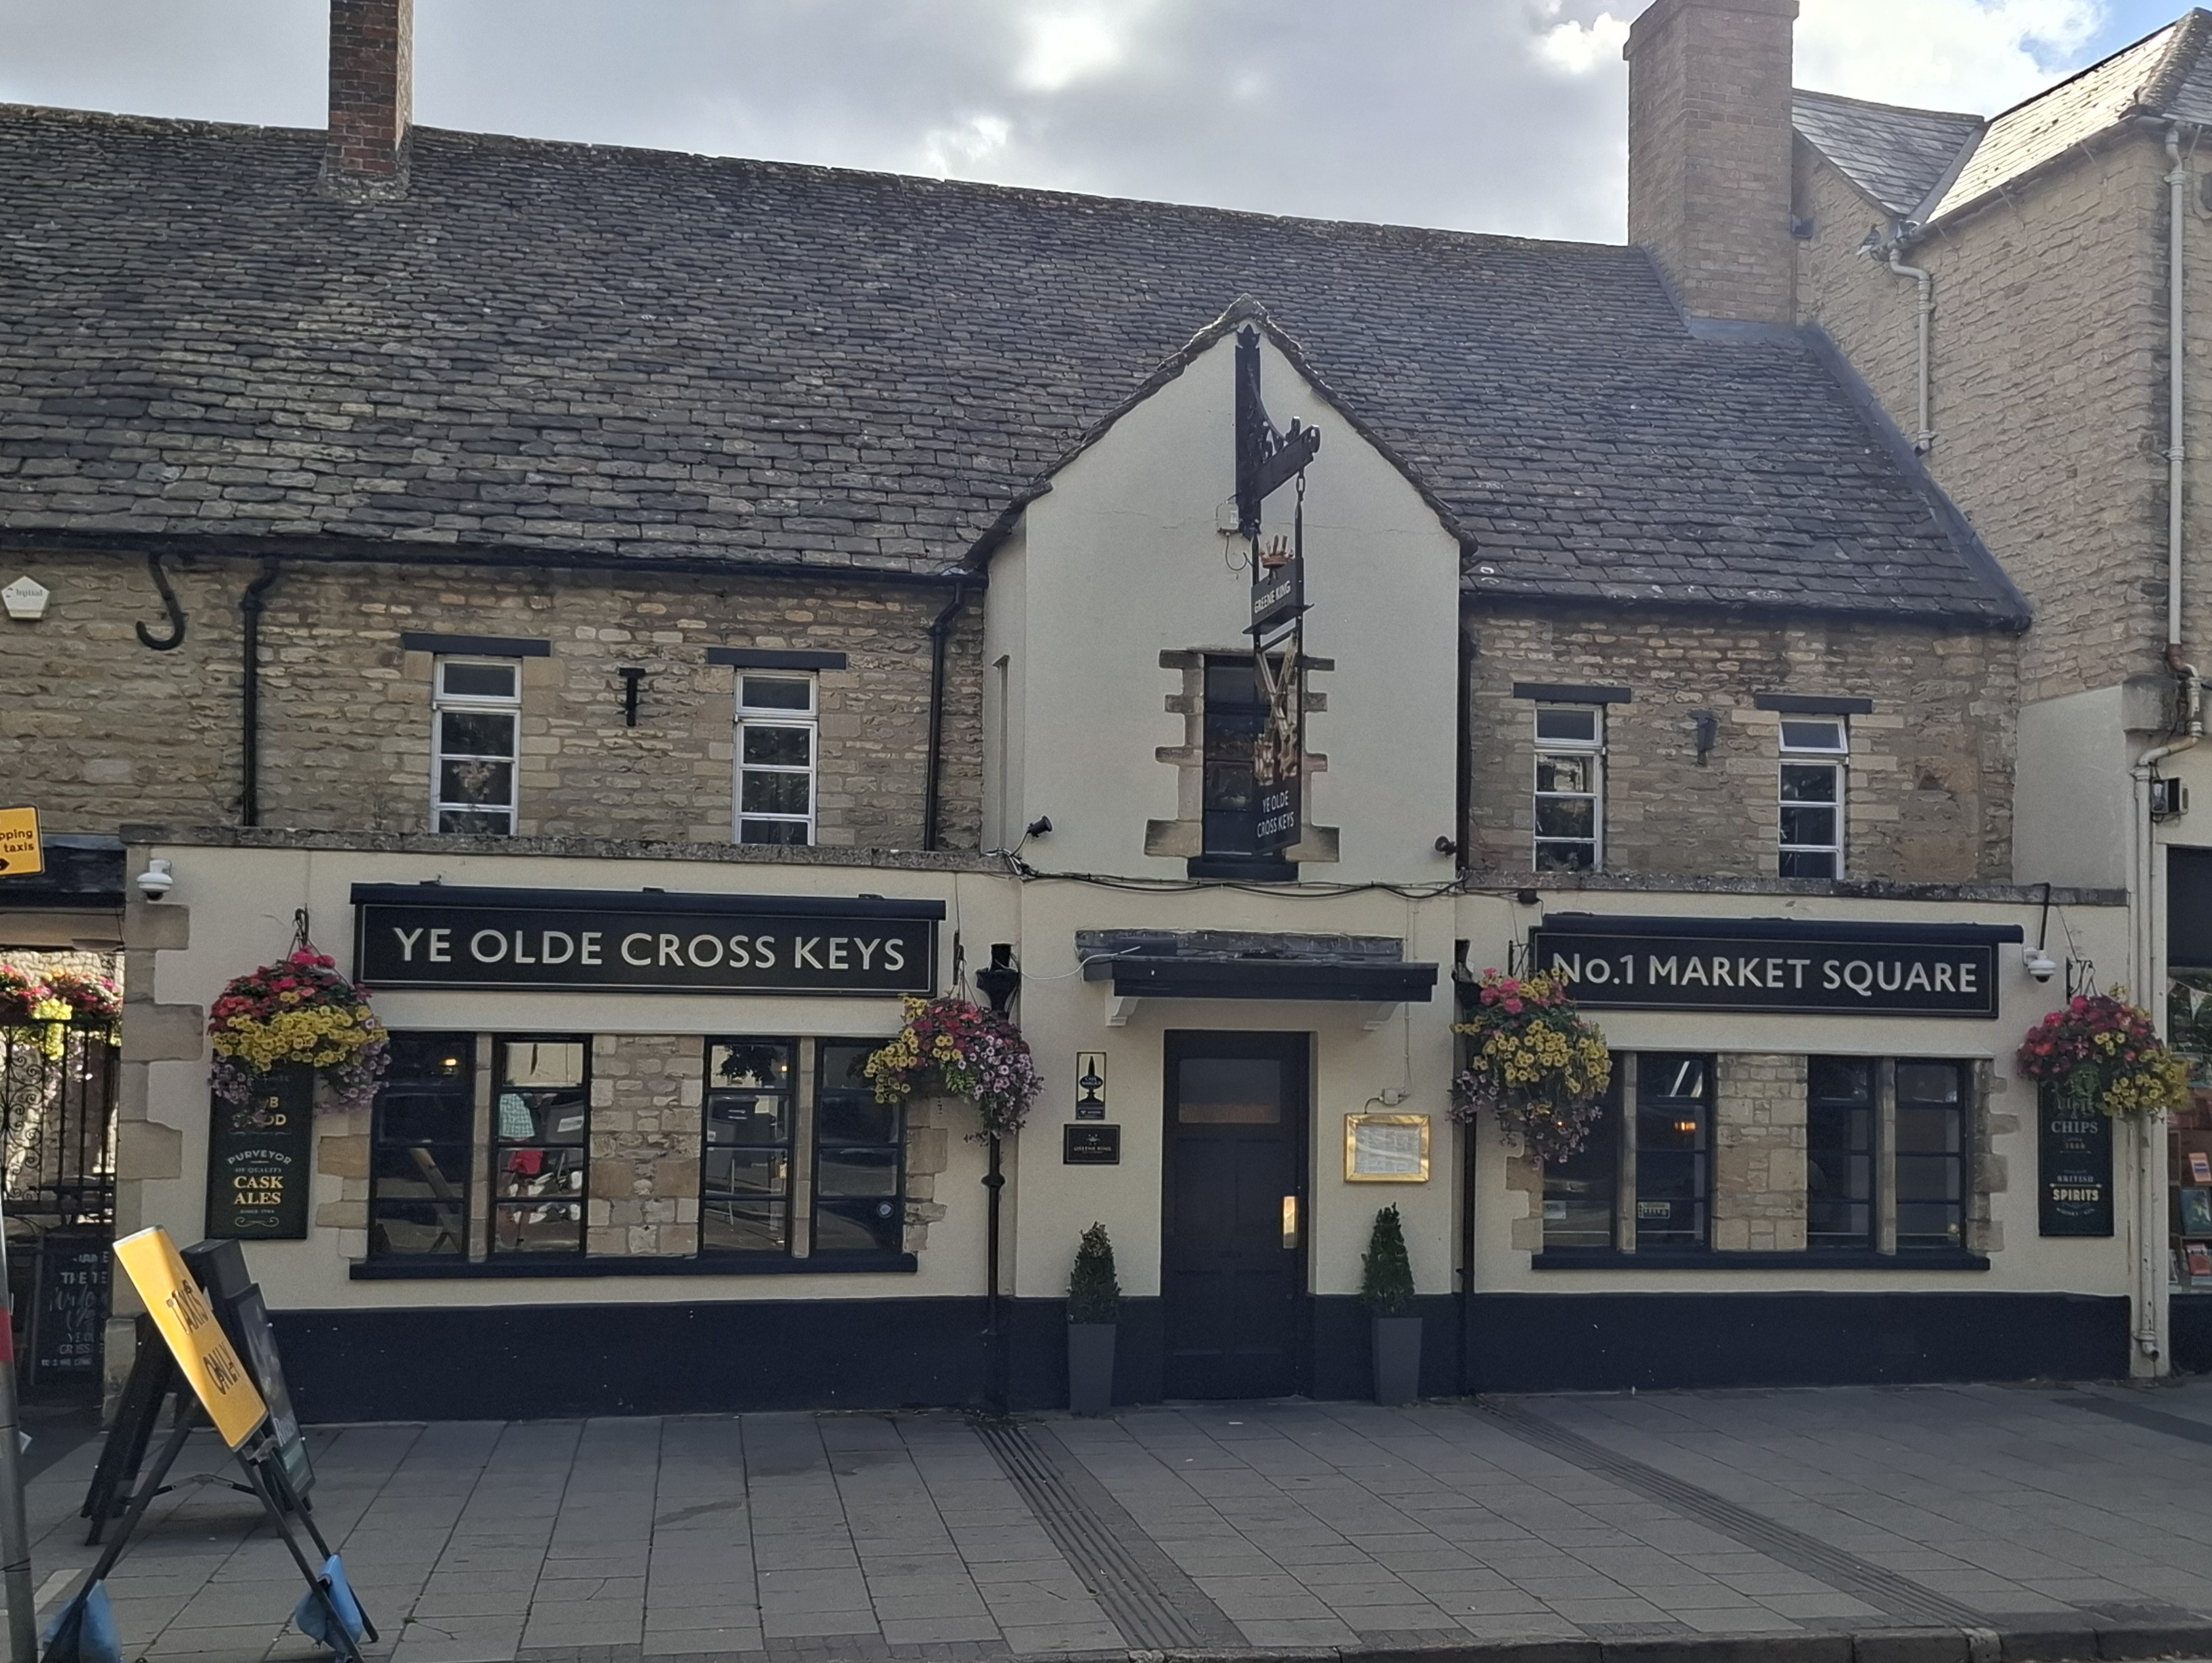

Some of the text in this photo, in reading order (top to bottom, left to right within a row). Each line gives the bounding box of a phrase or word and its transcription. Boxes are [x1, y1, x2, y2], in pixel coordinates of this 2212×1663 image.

[1254, 580, 1291, 614] GREENE KING
[1262, 790, 1289, 814] YE OLDE
[1257, 811, 1295, 838] CROSS KEYS
[4, 842, 34, 853] taxis
[393, 927, 905, 972] YE OLDE CROSS KEYS
[1649, 955, 1811, 988] MARKET
[1822, 959, 1977, 996] SQUARE
[2051, 1121, 2098, 1134] CHIPS
[227, 1149, 292, 1165] PURVEYOR
[233, 1176, 284, 1189] CASK
[233, 1192, 282, 1205] ALES
[2053, 1189, 2099, 1201] SPIRITS
[166, 1279, 209, 1334] TAXIS
[203, 1341, 241, 1396] ONLY
